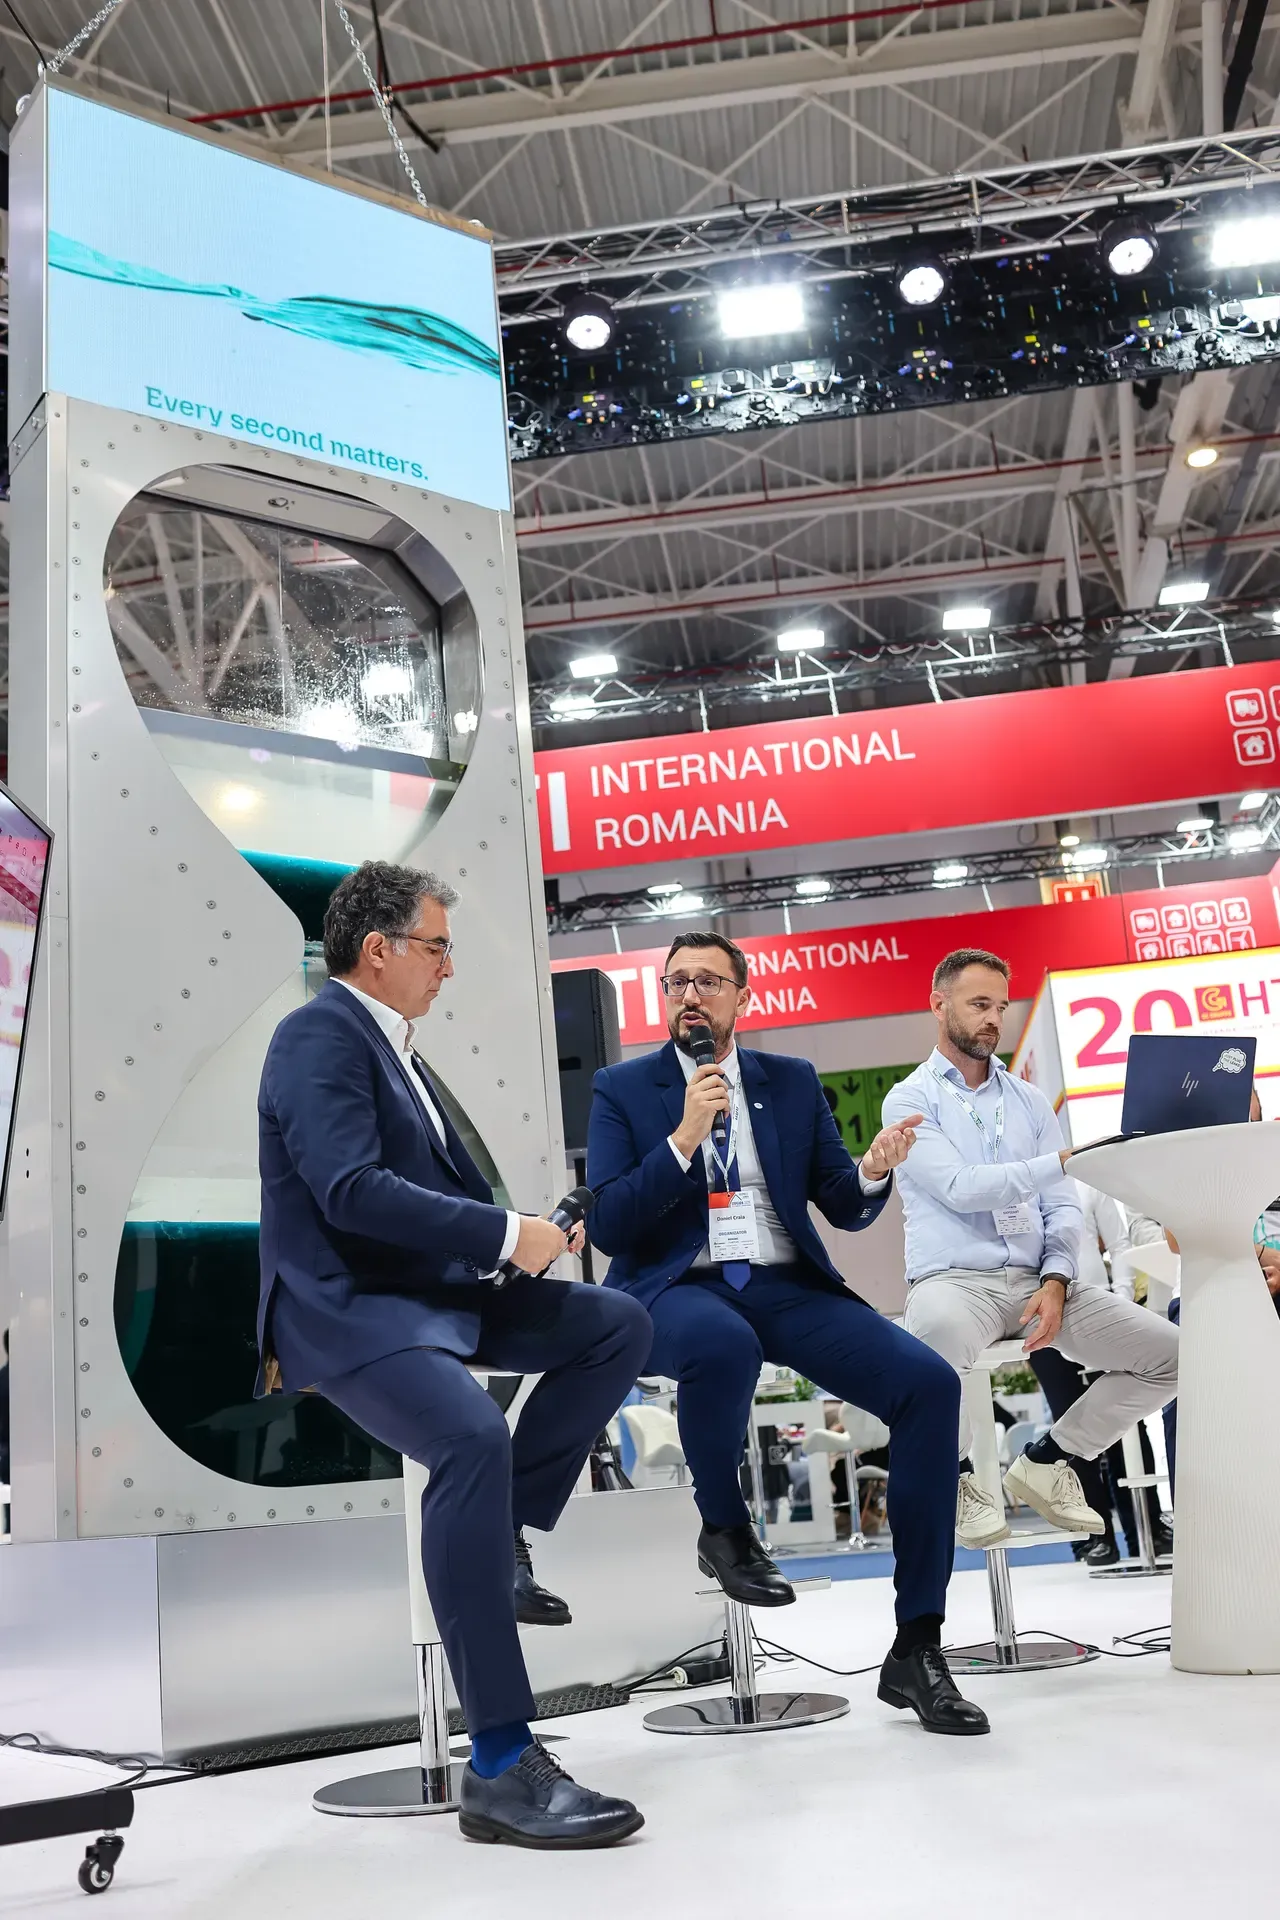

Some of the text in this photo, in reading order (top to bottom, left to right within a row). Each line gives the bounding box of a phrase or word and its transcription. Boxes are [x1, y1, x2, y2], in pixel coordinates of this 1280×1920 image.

[145, 385, 430, 481] Every second matters.
[590, 729, 916, 798] INTERNATIONAL
[594, 798, 789, 851] ROMANIA
[747, 936, 909, 978] RNATIONAL
[743, 986, 818, 1018] ANIA
[1181, 1071, 1199, 1097] hp
